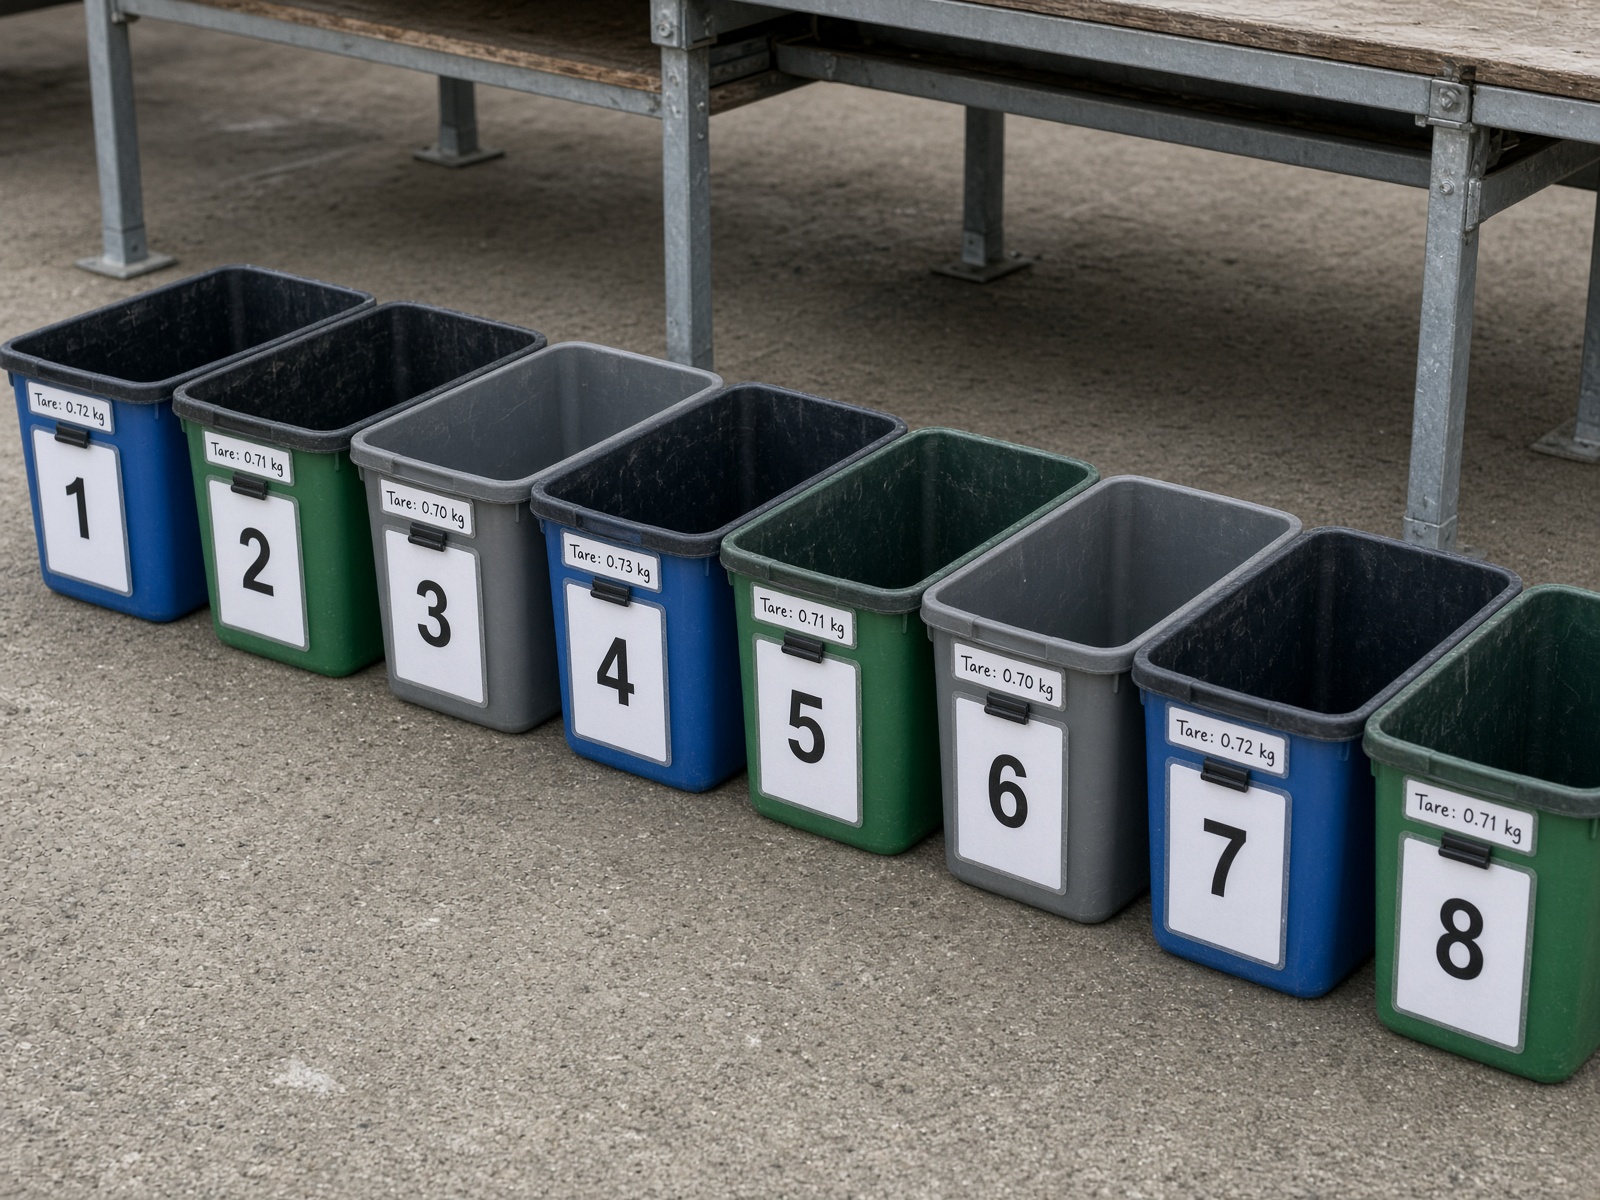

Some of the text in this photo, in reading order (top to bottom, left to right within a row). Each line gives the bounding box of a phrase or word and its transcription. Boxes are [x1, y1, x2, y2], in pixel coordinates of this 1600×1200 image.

[33, 392, 105, 427] Tare: 0.72 kg
[210, 441, 284, 478] Tare: 0.71 kg
[65, 476, 90, 540] 1
[385, 490, 465, 530] Tare: 0.70 kg
[239, 527, 275, 597] 2
[569, 543, 651, 584] Tare: 0.73 kg
[416, 579, 452, 648] 3
[759, 596, 845, 640] Tare: 0.71 kg
[596, 636, 635, 707] 4
[960, 654, 1054, 702] Tare: 0.70 kg
[787, 689, 826, 764] 5
[1175, 718, 1275, 768] Tare: 0.72 kg
[988, 753, 1028, 829] 6
[1414, 792, 1522, 845] Tare: 0.71 kg
[1203, 817, 1247, 898] 7
[1435, 897, 1484, 981] 8
